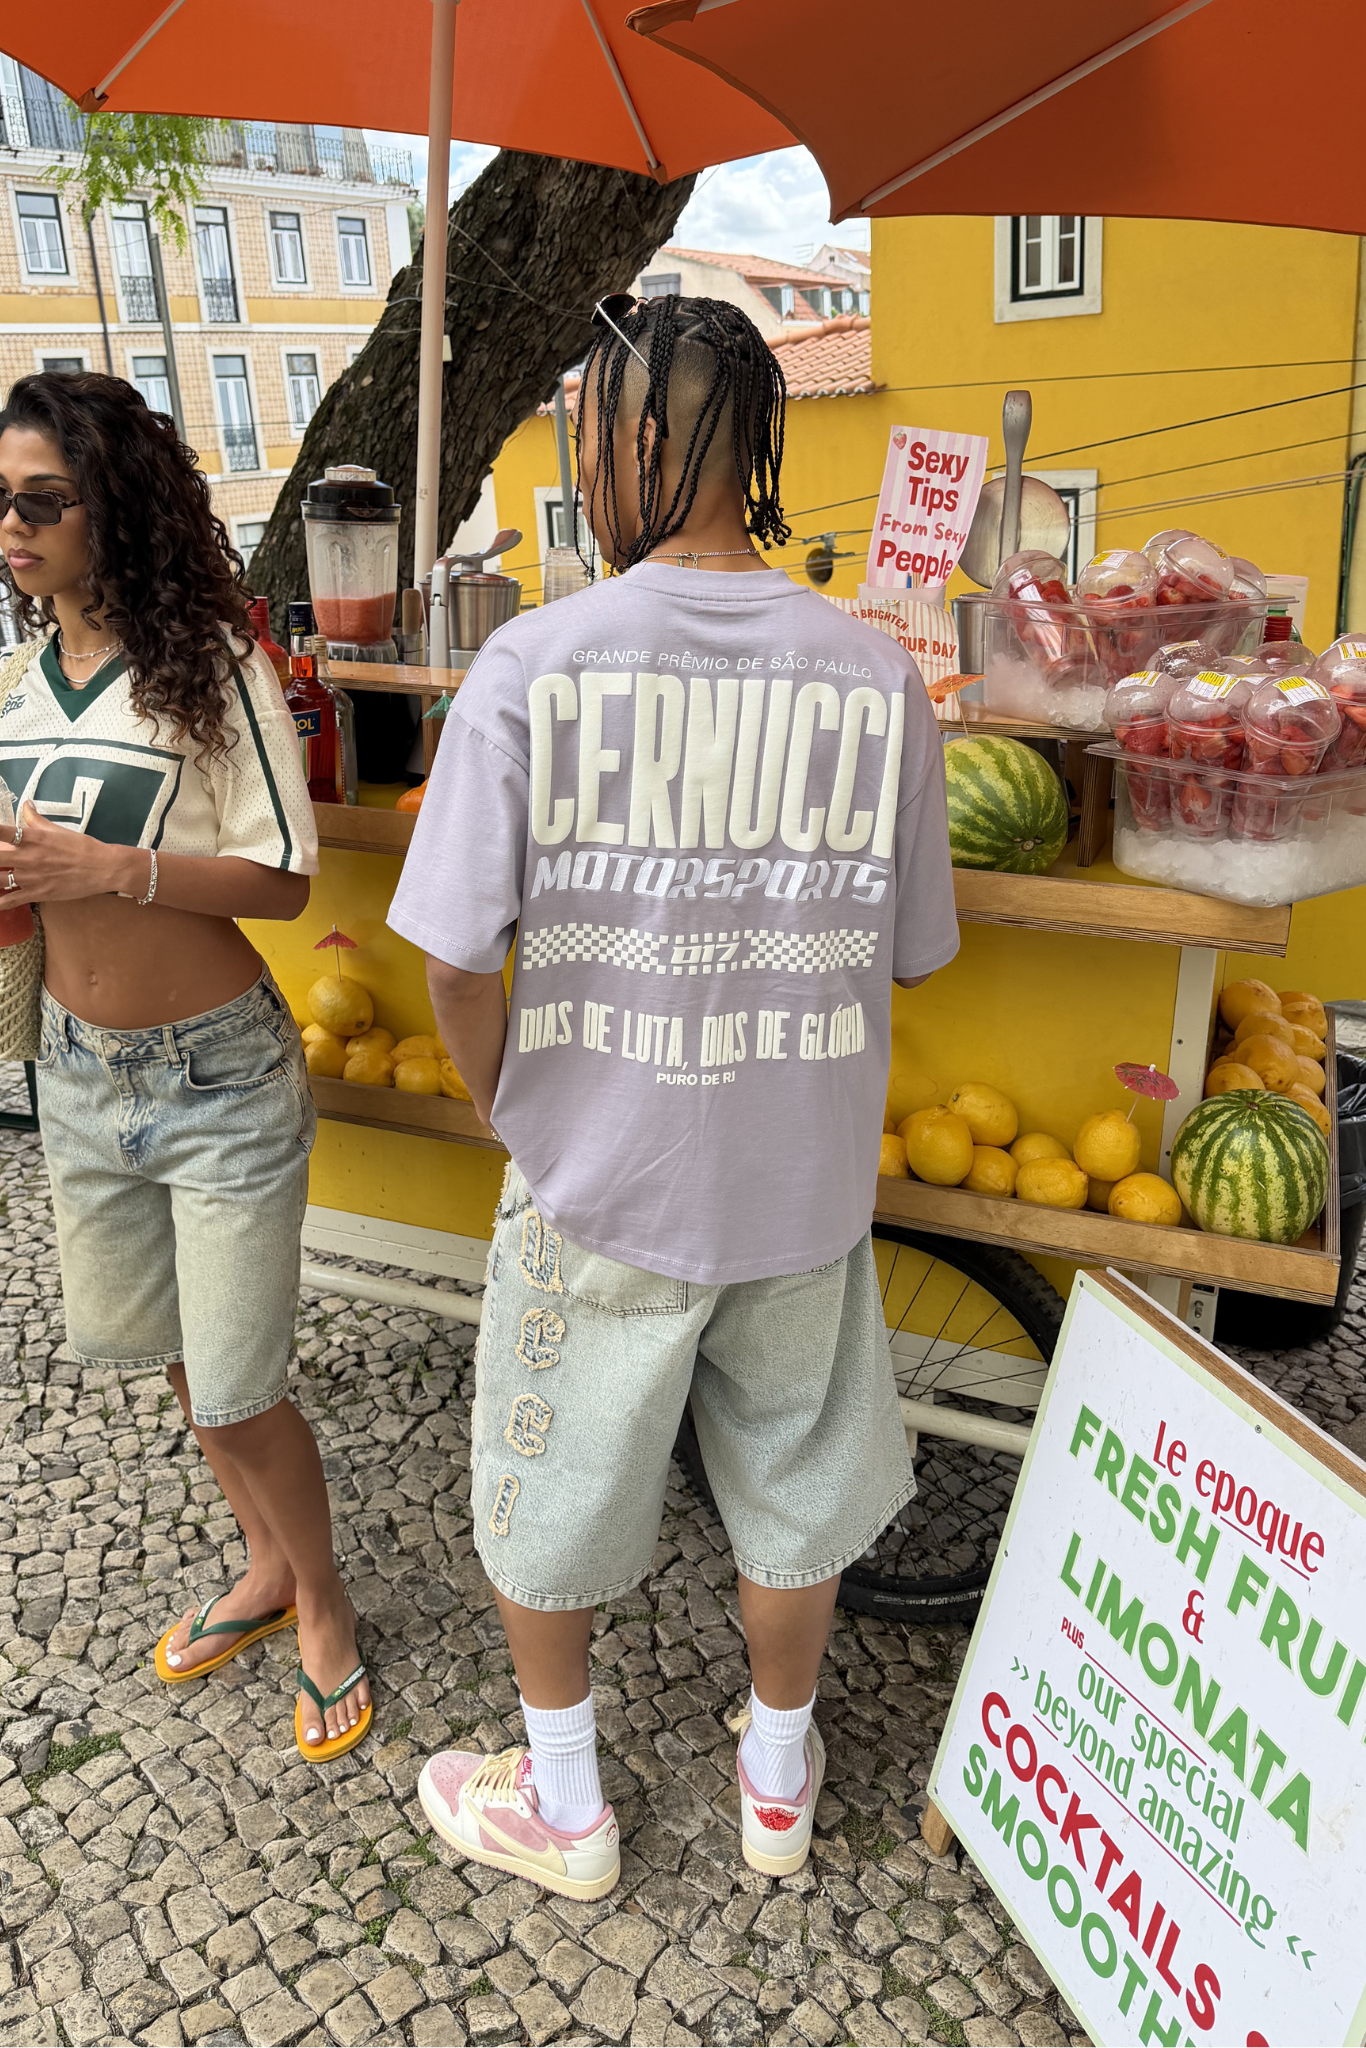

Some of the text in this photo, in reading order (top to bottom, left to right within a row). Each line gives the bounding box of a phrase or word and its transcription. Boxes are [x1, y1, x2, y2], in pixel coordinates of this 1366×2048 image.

[908, 441, 969, 483] Sexy
[908, 475, 959, 517] Tips
[879, 513, 967, 551] From Sexy
[876, 539, 954, 584] People
[860, 608, 909, 632] BRIGHTEN
[572, 650, 872, 679] GRANDE PRÊMIO DE SÃO PAULO
[932, 640, 957, 659] DAY
[529, 672, 905, 859] CERNUCCI
[530, 850, 891, 904] MOTORSPORTS
[518, 1000, 866, 1072] DIAS DE LUTA, DIAS DE GLÓRIA
[656, 1071, 736, 1087] PURO DE RJ
[1153, 1420, 1325, 1574] Le epoque
[1069, 1403, 1366, 1744] FRESH FRUI
[1060, 1616, 1085, 1649] PLUS
[1182, 1589, 1206, 1644] &
[1059, 1530, 1312, 1855] LIMONATA
[1077, 1662, 1246, 1845] our special
[1034, 1670, 1278, 1950] beyond amazing
[981, 1691, 1222, 2031] COCKTAILS
[962, 1743, 1196, 2048] SMOOOTH
